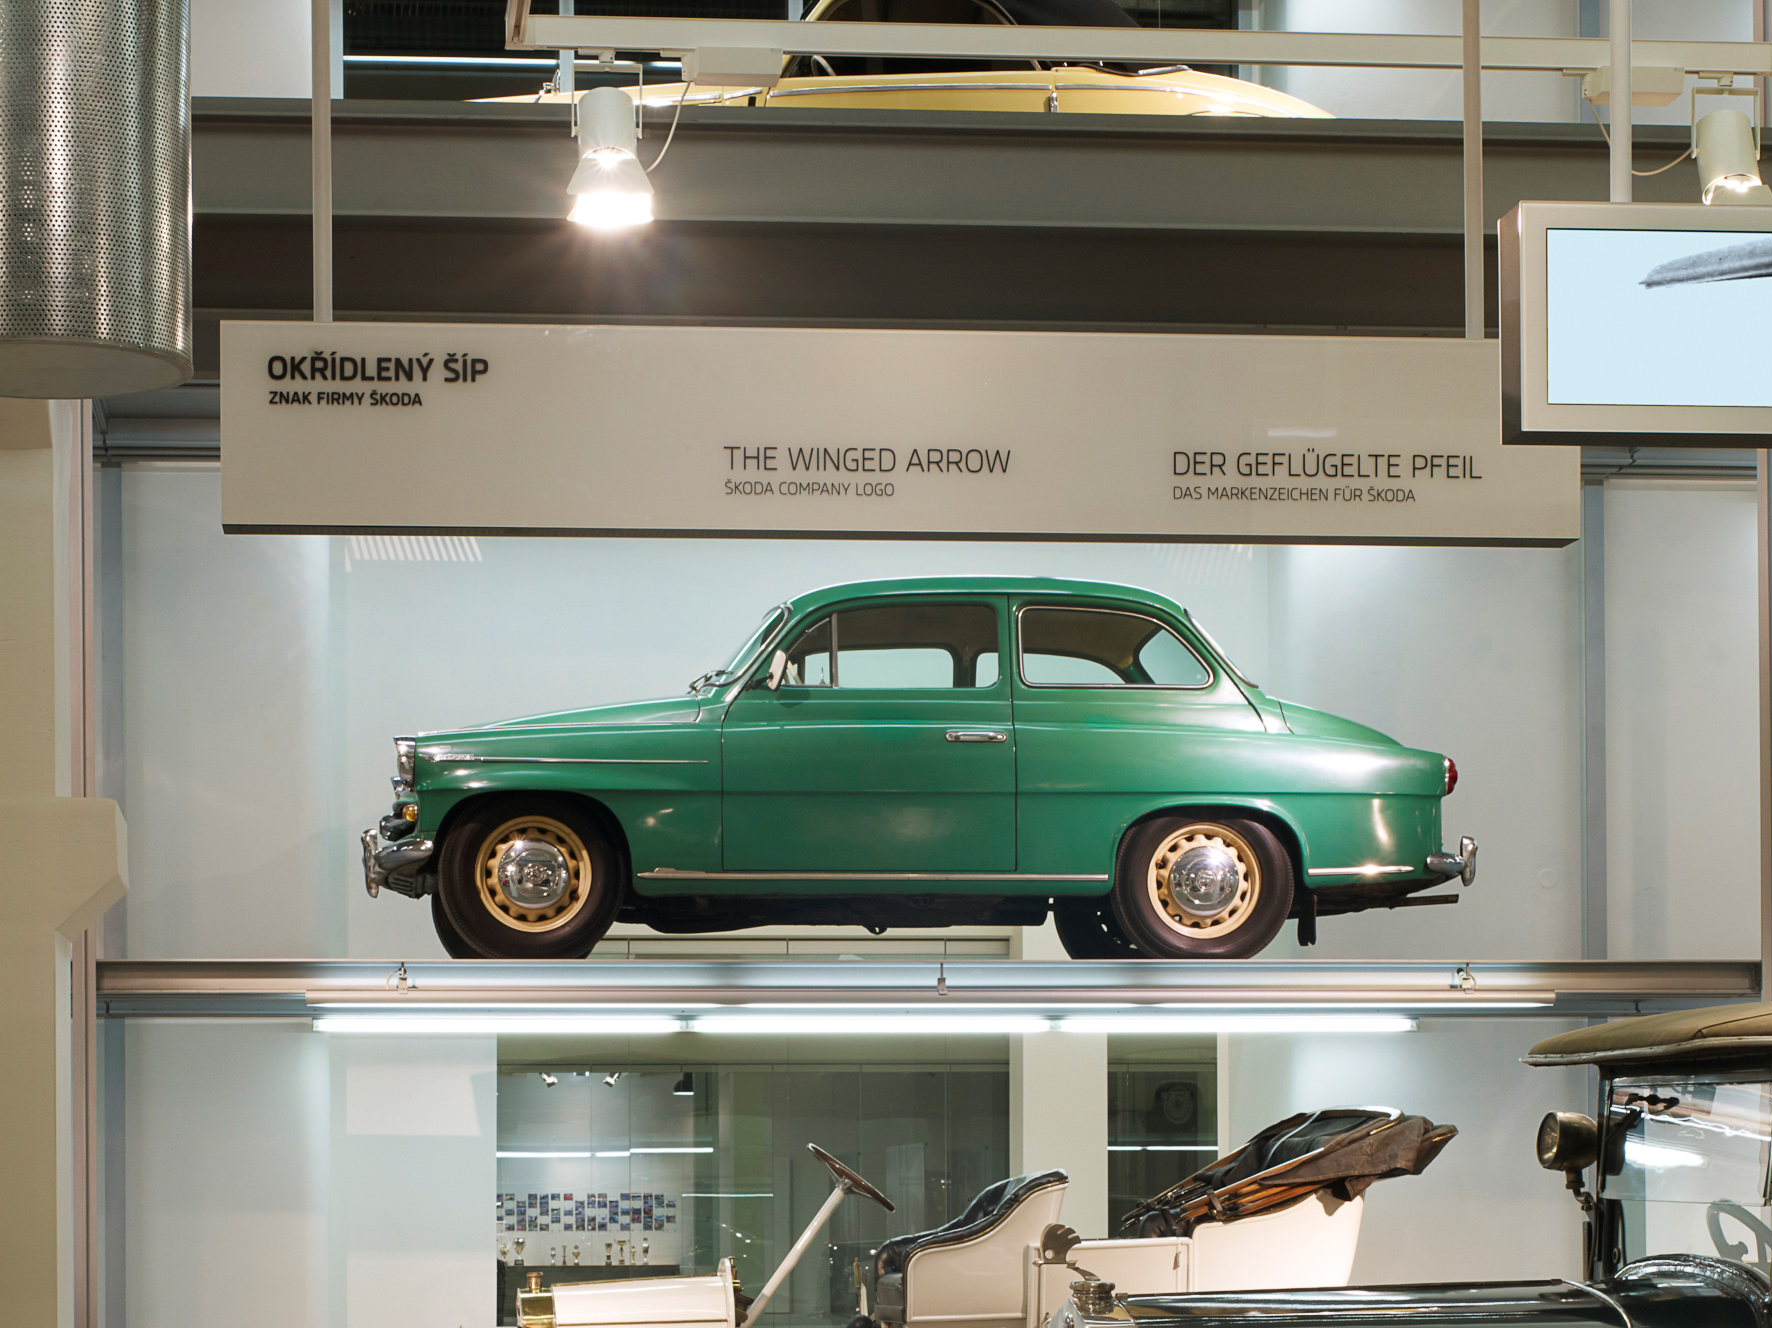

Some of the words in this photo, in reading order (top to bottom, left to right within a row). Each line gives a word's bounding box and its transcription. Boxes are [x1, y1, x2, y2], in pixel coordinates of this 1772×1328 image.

[266, 350, 435, 383] OKŘÍDLENÝ
[442, 352, 490, 384] ŠÍP
[268, 390, 313, 406] ZNAK
[316, 391, 366, 406] FIRMY
[368, 388, 424, 408] ŠKODA
[722, 445, 778, 472] THE
[787, 446, 897, 474] WINGED
[905, 448, 1012, 475] ARROW
[1172, 450, 1227, 477] DER
[1236, 447, 1402, 479] GEFLÜGELTE
[1411, 453, 1483, 480] PFEIL
[724, 478, 775, 496] ŠKODA
[778, 481, 851, 496] COMPANY
[855, 482, 895, 497] LOGO
[1172, 485, 1203, 501] DAS
[1207, 486, 1329, 502] MARKENZEICHEN
[1333, 485, 1363, 502] FÜR
[1367, 485, 1416, 503] ŠKODA
